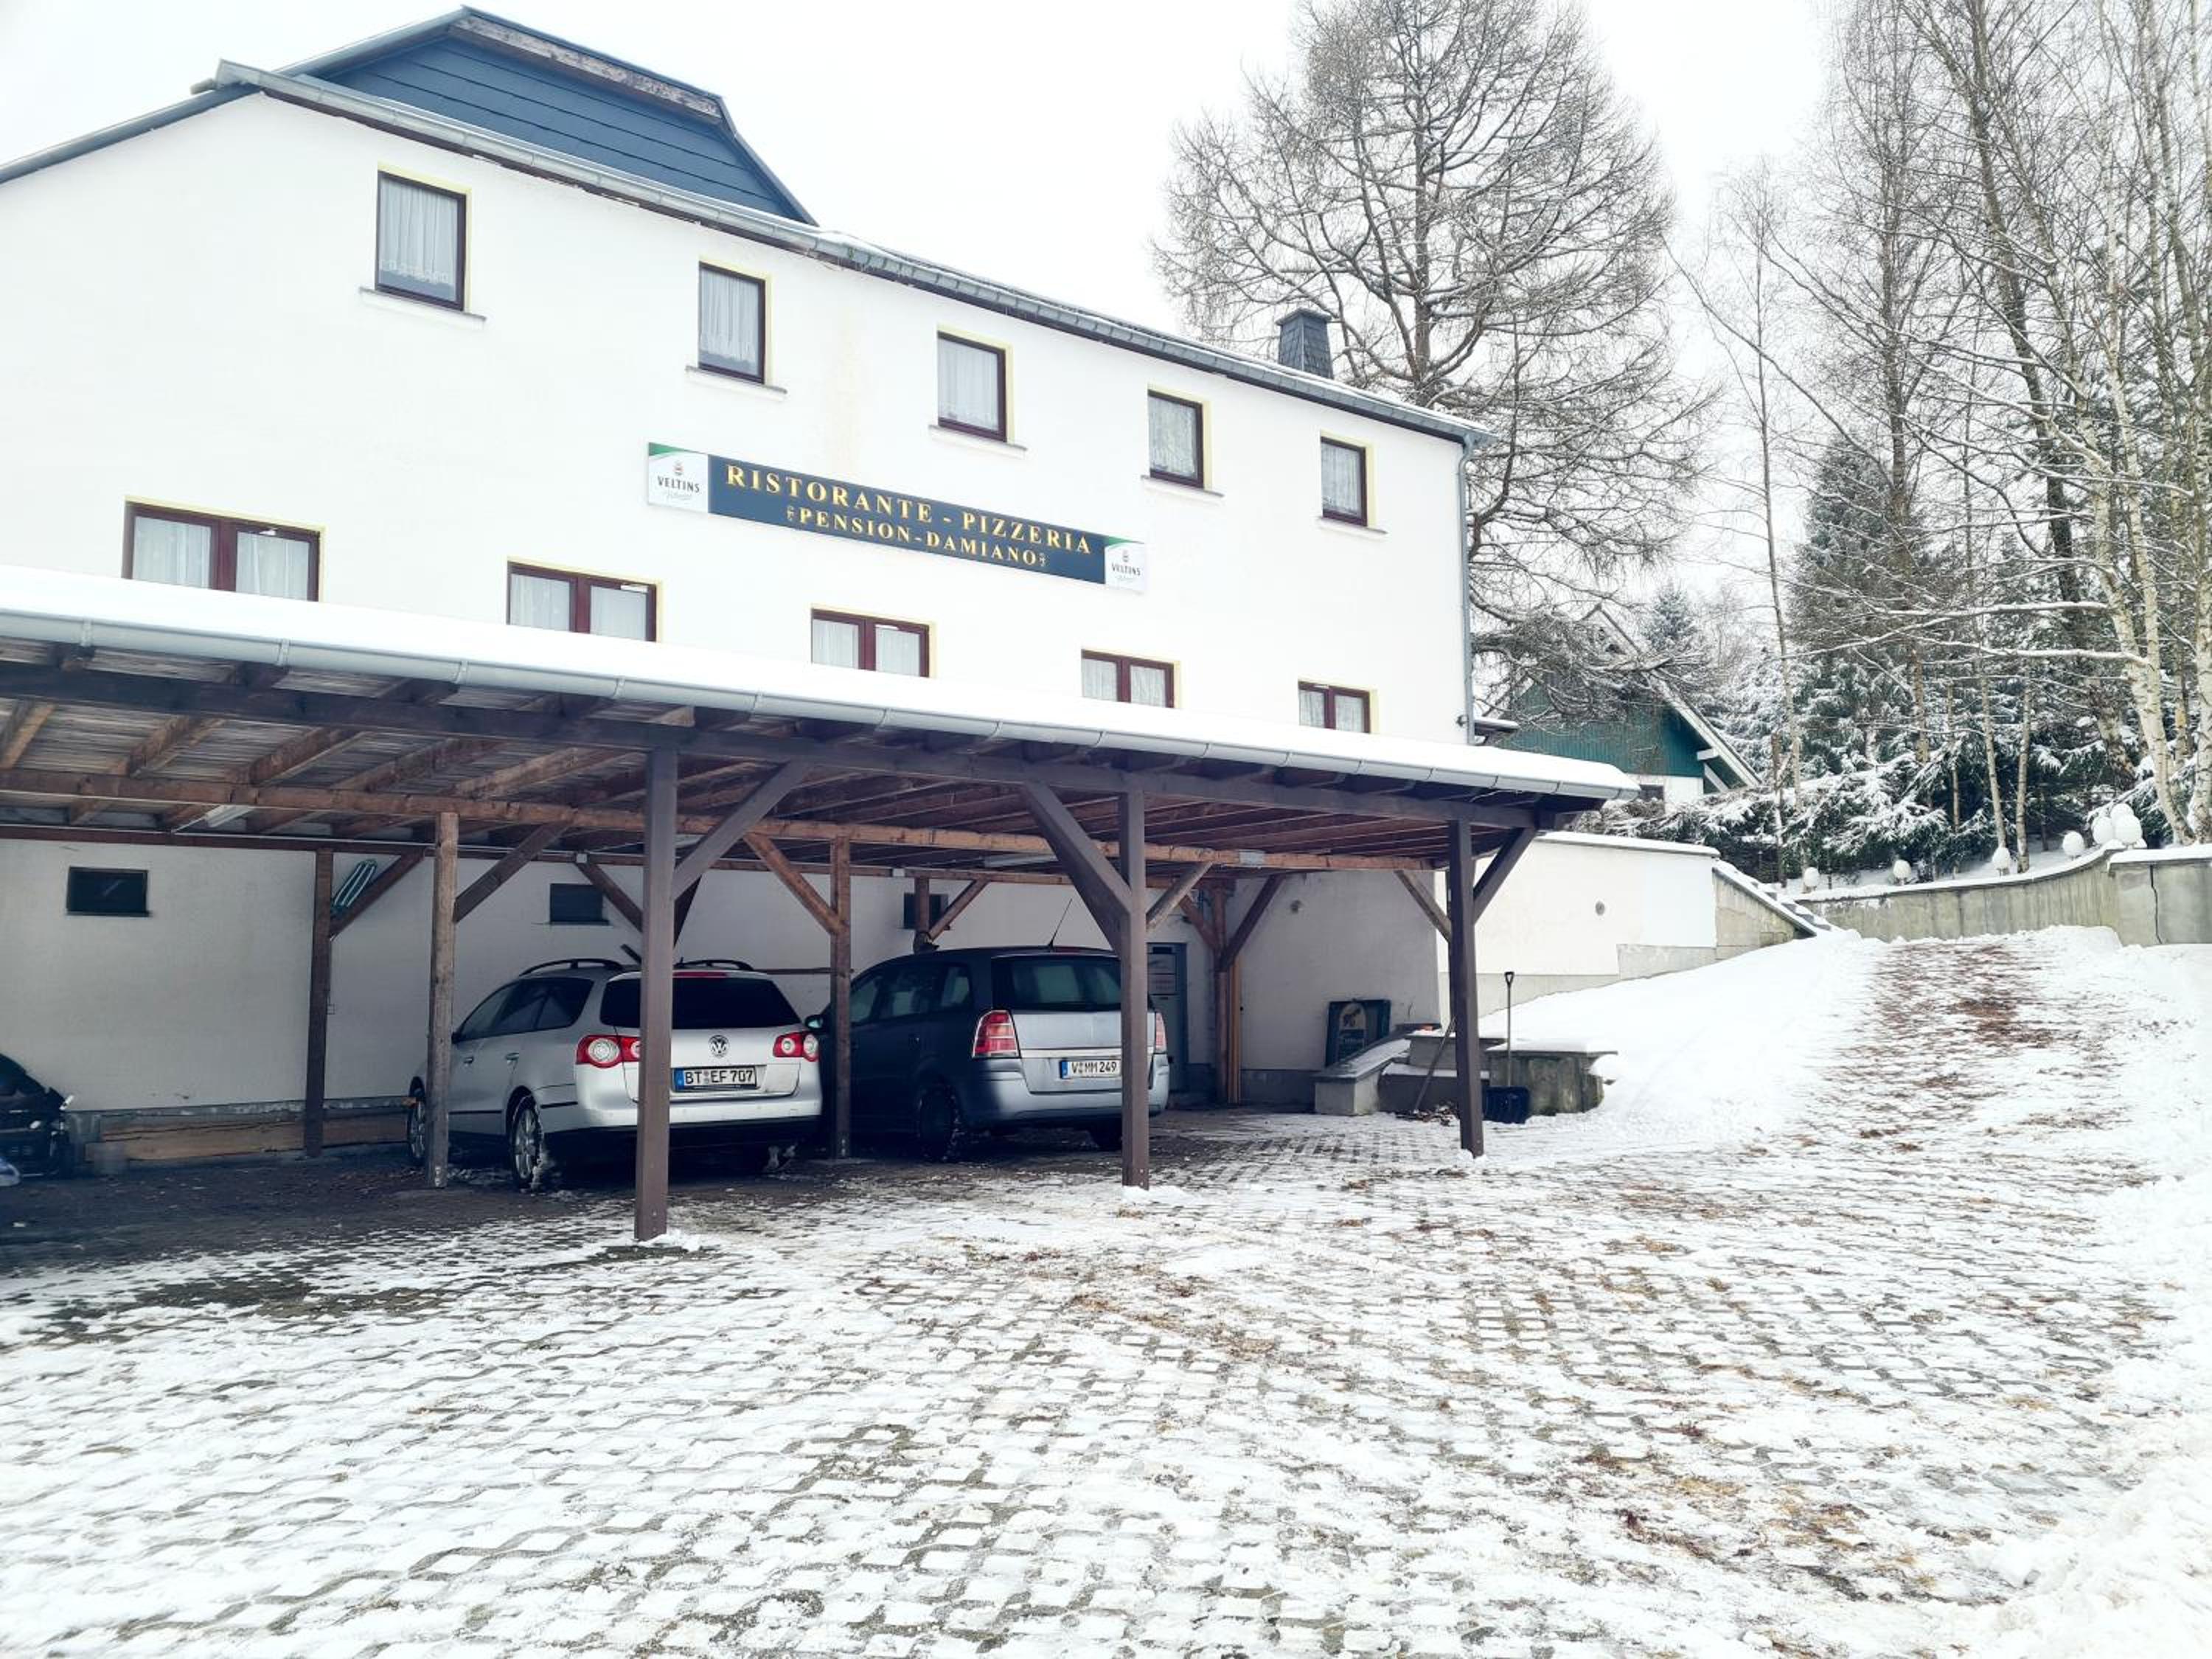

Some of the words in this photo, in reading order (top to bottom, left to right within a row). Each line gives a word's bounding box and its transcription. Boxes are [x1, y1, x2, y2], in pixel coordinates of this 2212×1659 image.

[657, 475, 700, 493] VELTINS
[726, 464, 932, 523] RISTORANTE
[962, 512, 1091, 554] PIZZERIA
[685, 1071, 702, 1084] BT
[711, 1070, 728, 1082] EF
[730, 1070, 753, 1082] 707
